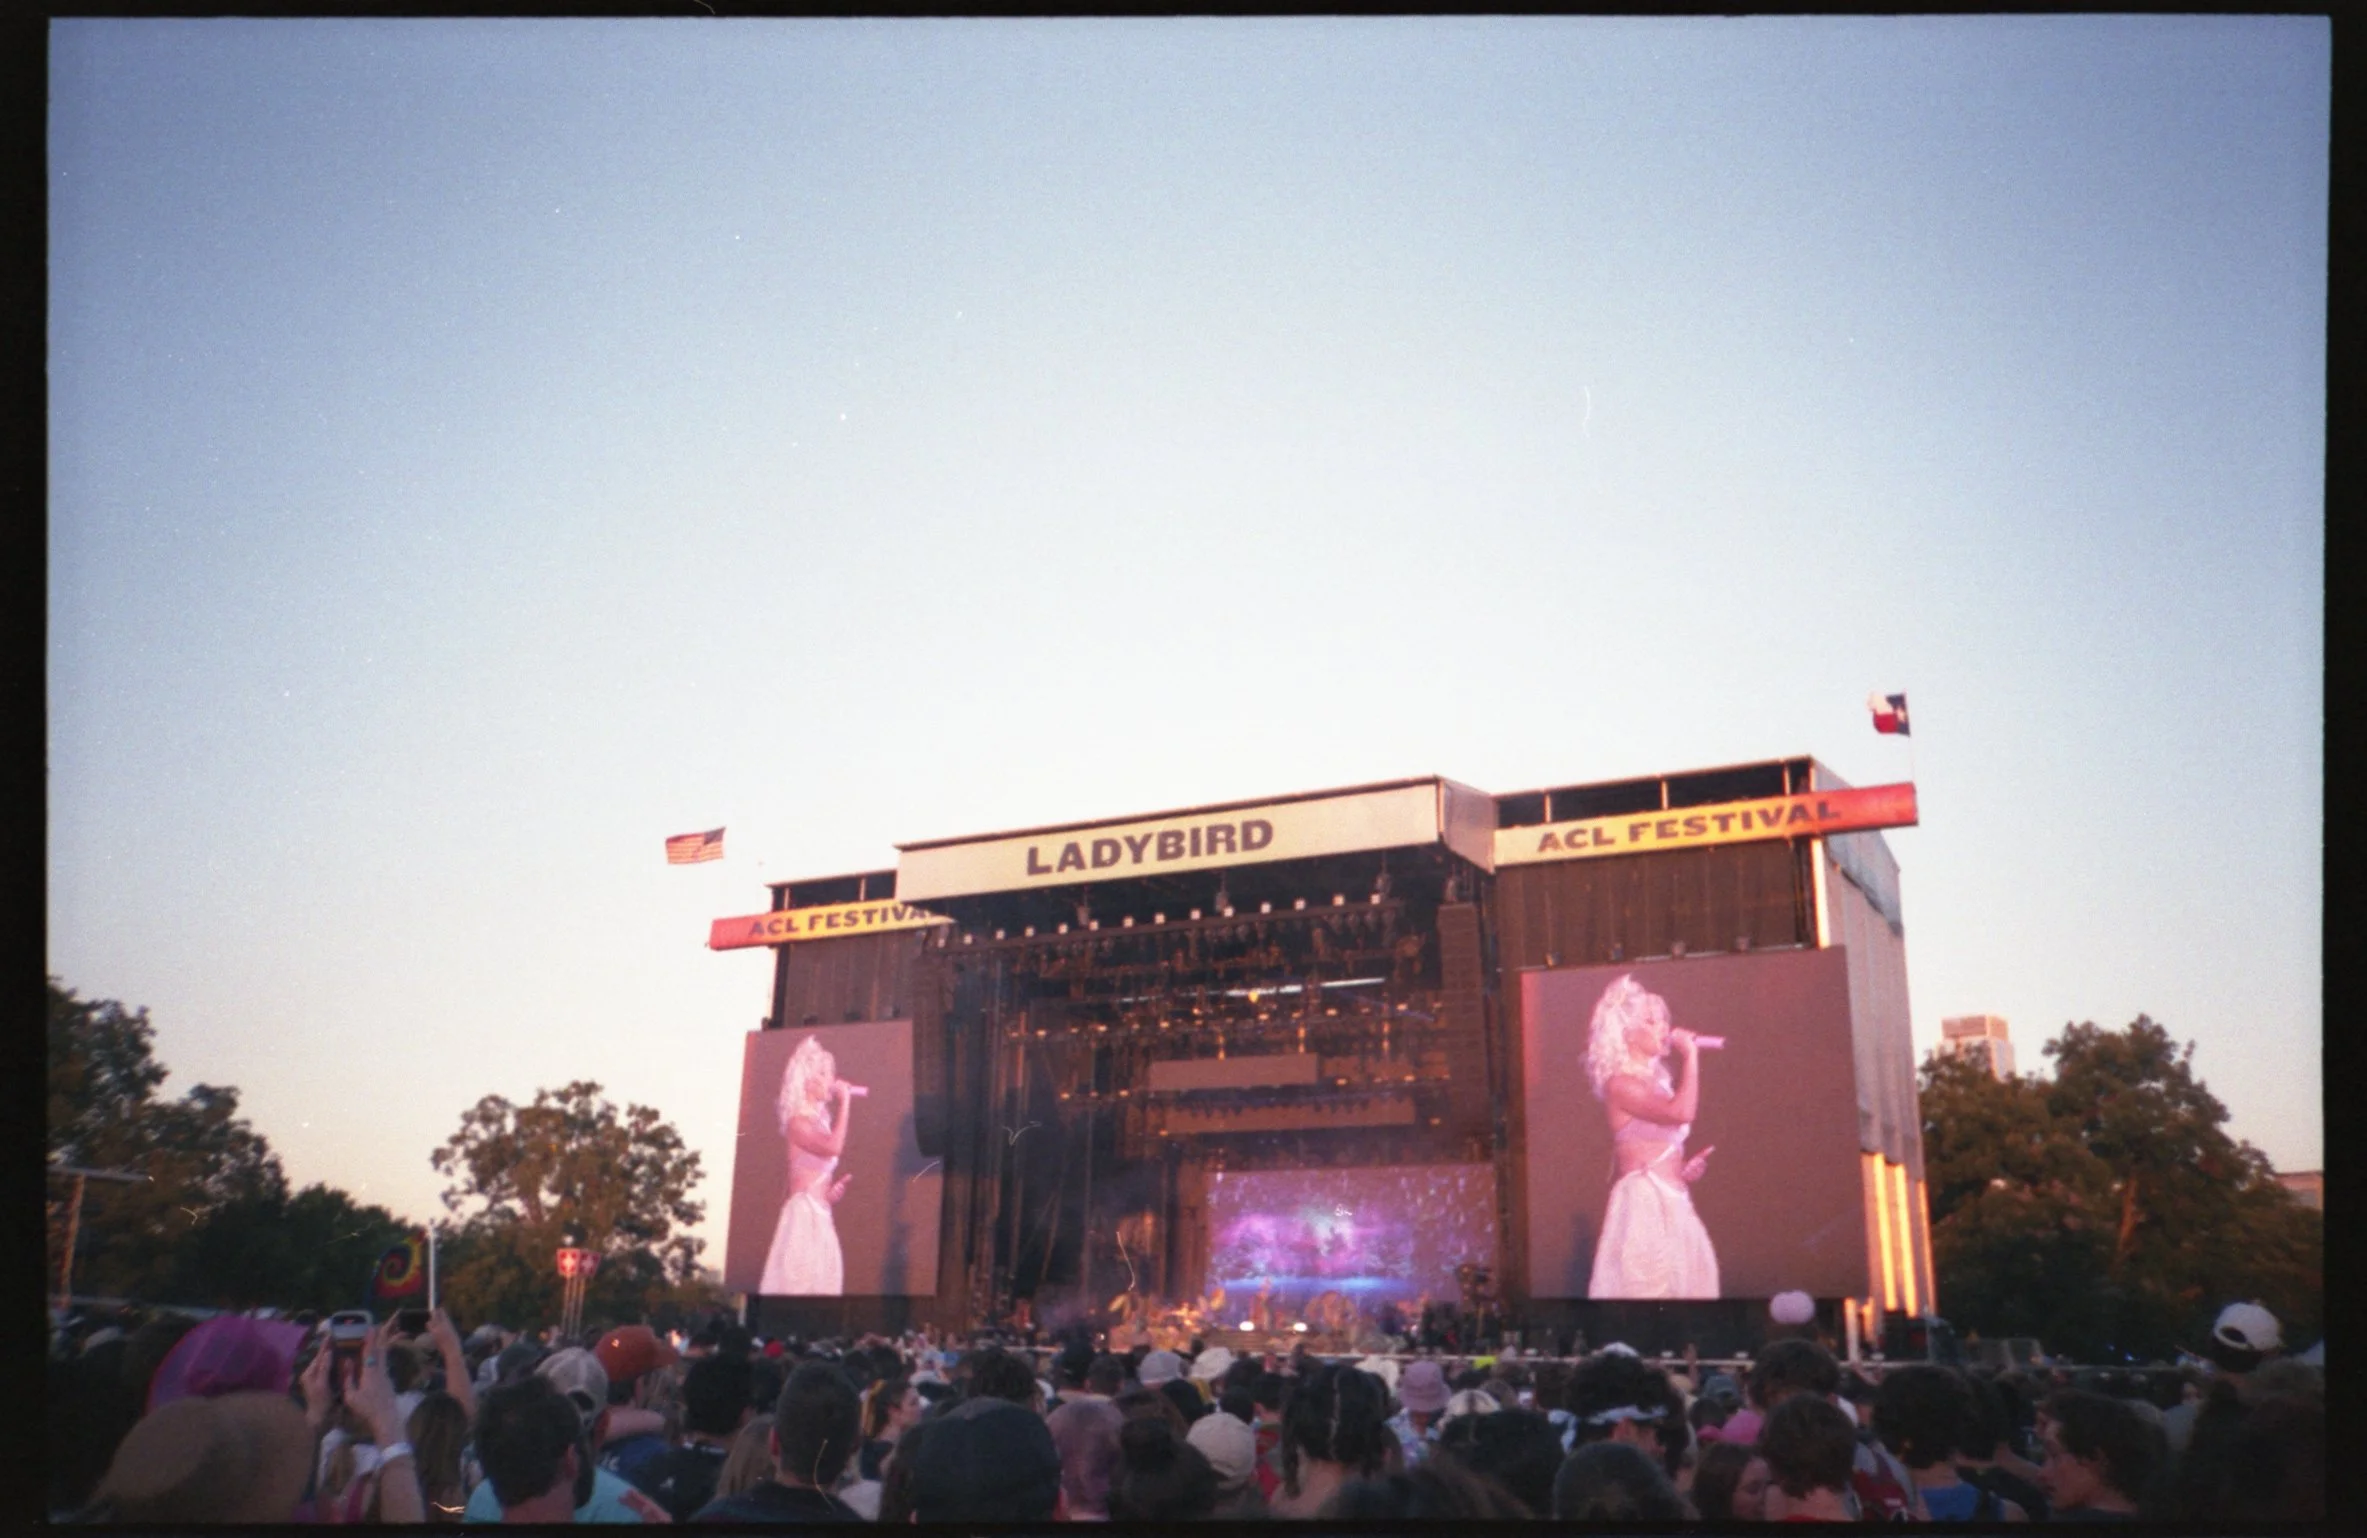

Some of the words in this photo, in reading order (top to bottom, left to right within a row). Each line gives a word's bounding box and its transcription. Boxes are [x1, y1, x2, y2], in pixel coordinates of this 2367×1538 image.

[1026, 818, 1274, 876] LADYBIRD
[1537, 827, 1618, 854] ACL
[1628, 800, 1842, 843] FESTIVAL
[748, 919, 800, 937] ACL
[808, 903, 930, 931] FESTIVA
